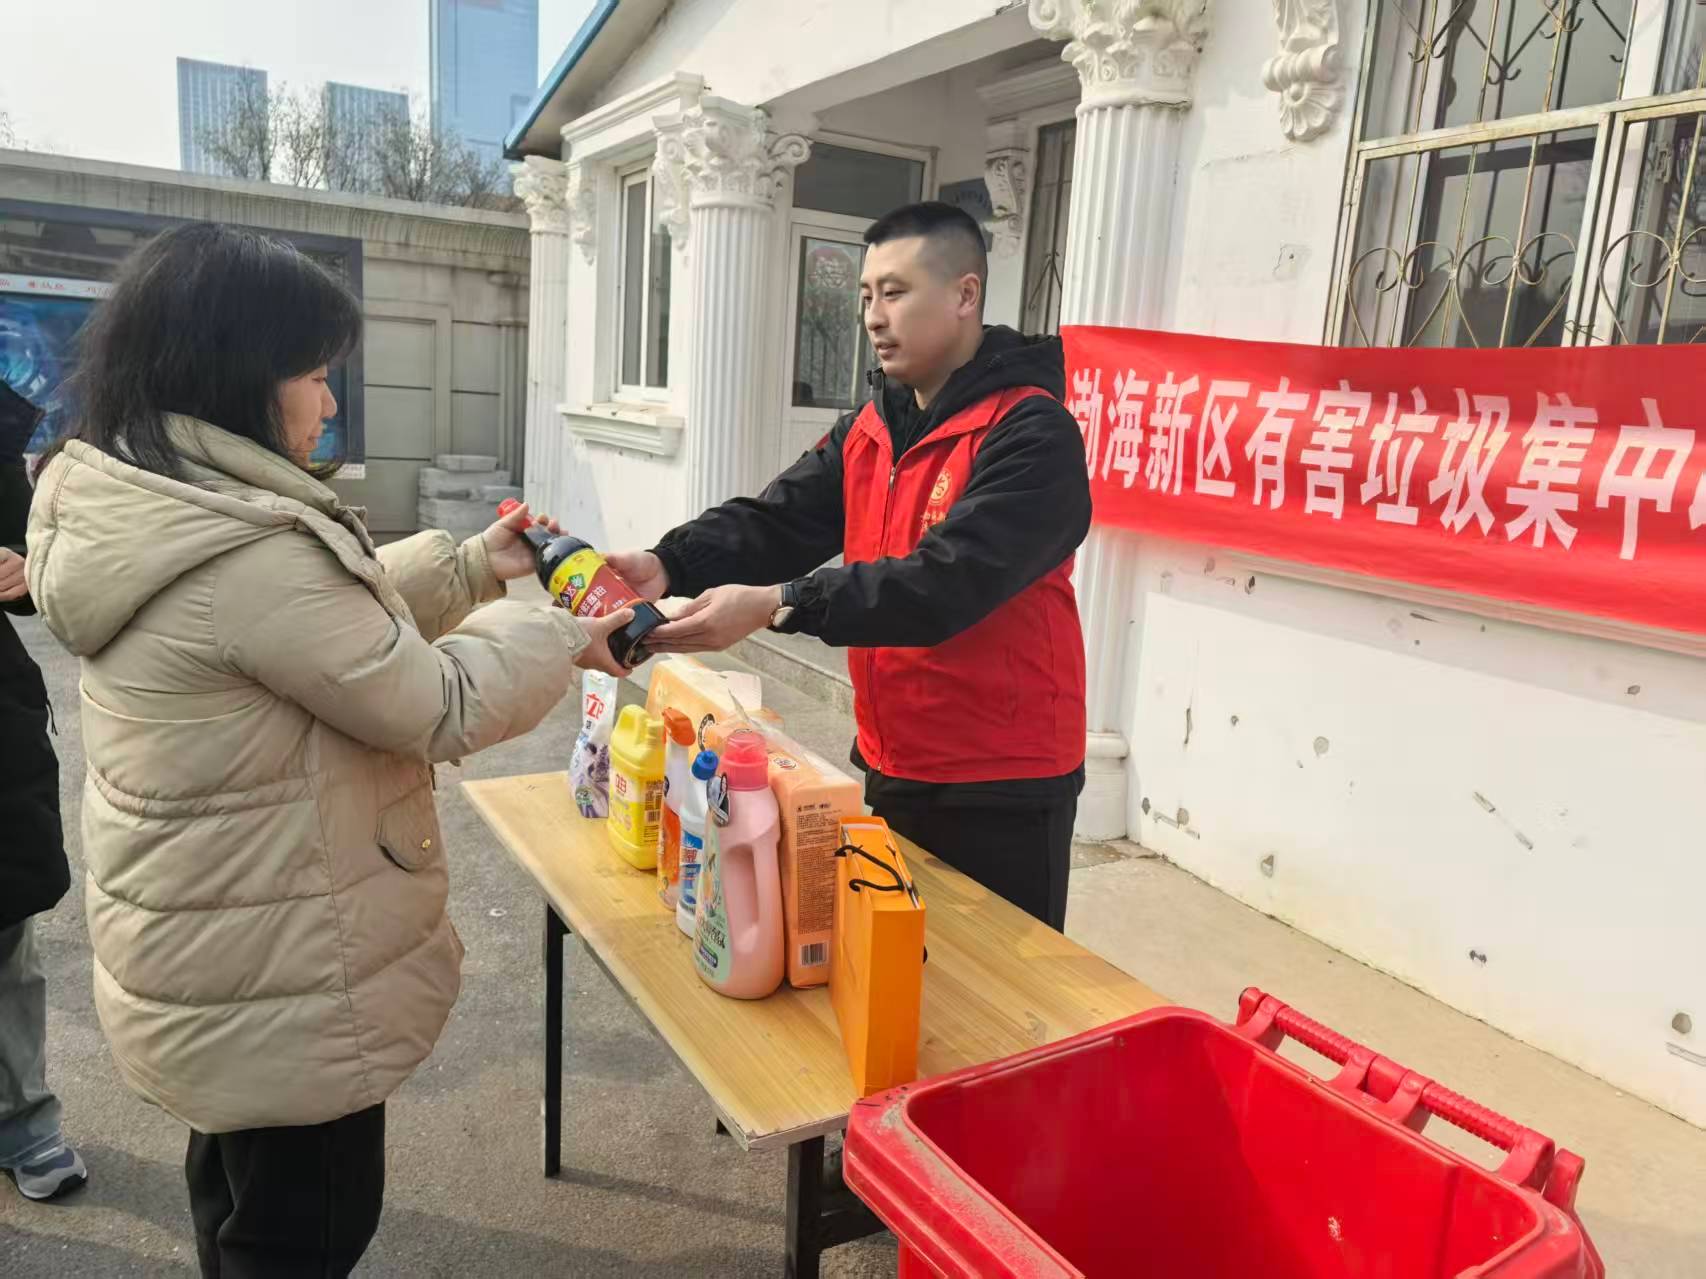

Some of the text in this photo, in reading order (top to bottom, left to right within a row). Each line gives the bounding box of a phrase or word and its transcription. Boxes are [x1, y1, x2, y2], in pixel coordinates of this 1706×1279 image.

[1068, 368, 1706, 560] 渤海新区有害垃圾集中
